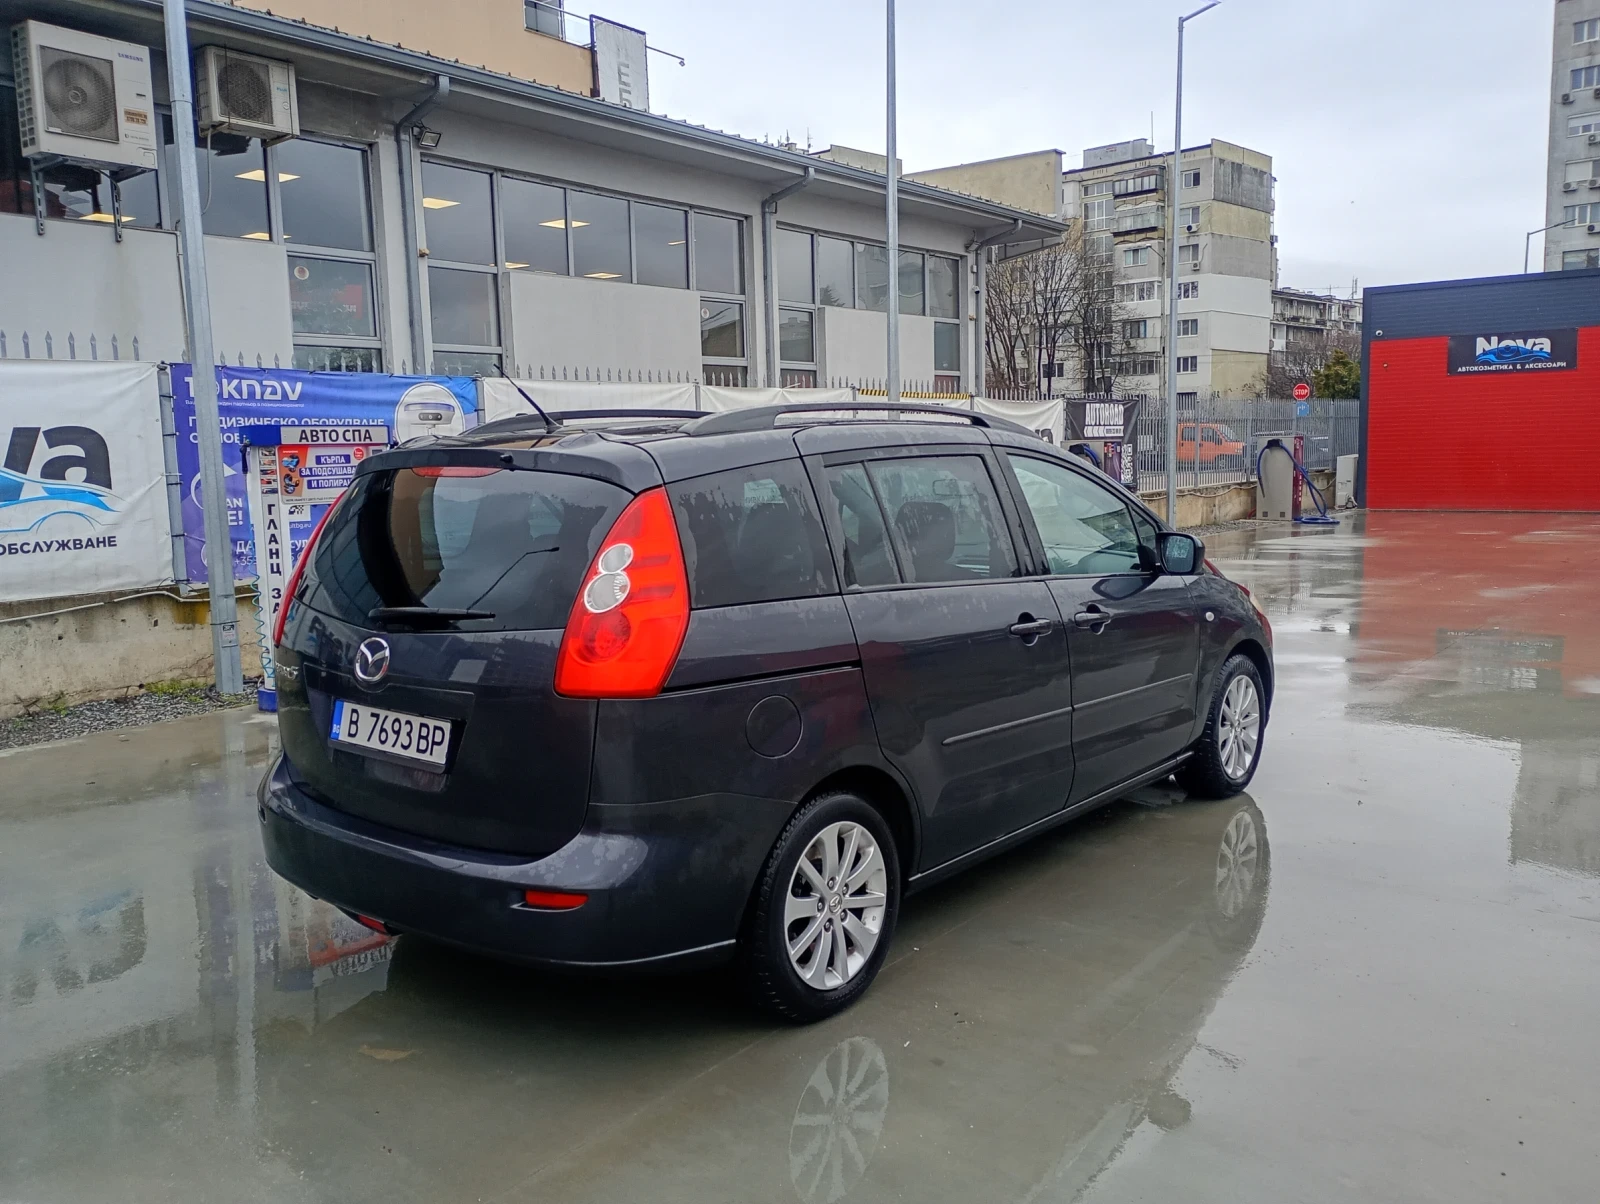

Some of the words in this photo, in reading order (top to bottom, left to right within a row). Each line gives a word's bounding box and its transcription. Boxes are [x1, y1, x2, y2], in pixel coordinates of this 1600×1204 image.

[117, 52, 144, 62] SAMSUNG
[1457, 364, 1513, 373] АВТОКОЗМЕТИКА
[1525, 361, 1567, 370] АКСЕСОАРИ
[1085, 403, 1124, 426] AUTOROAD
[299, 429, 339, 443] АВТО
[342, 428, 373, 442] СПА
[320, 456, 346, 464] КЪРПА
[300, 468, 311, 476] ЗА
[312, 467, 356, 477] ПОДСУШАВА
[311, 480, 317, 488] И
[267, 504, 282, 576] ГЛАНЦ
[347, 708, 360, 738] B
